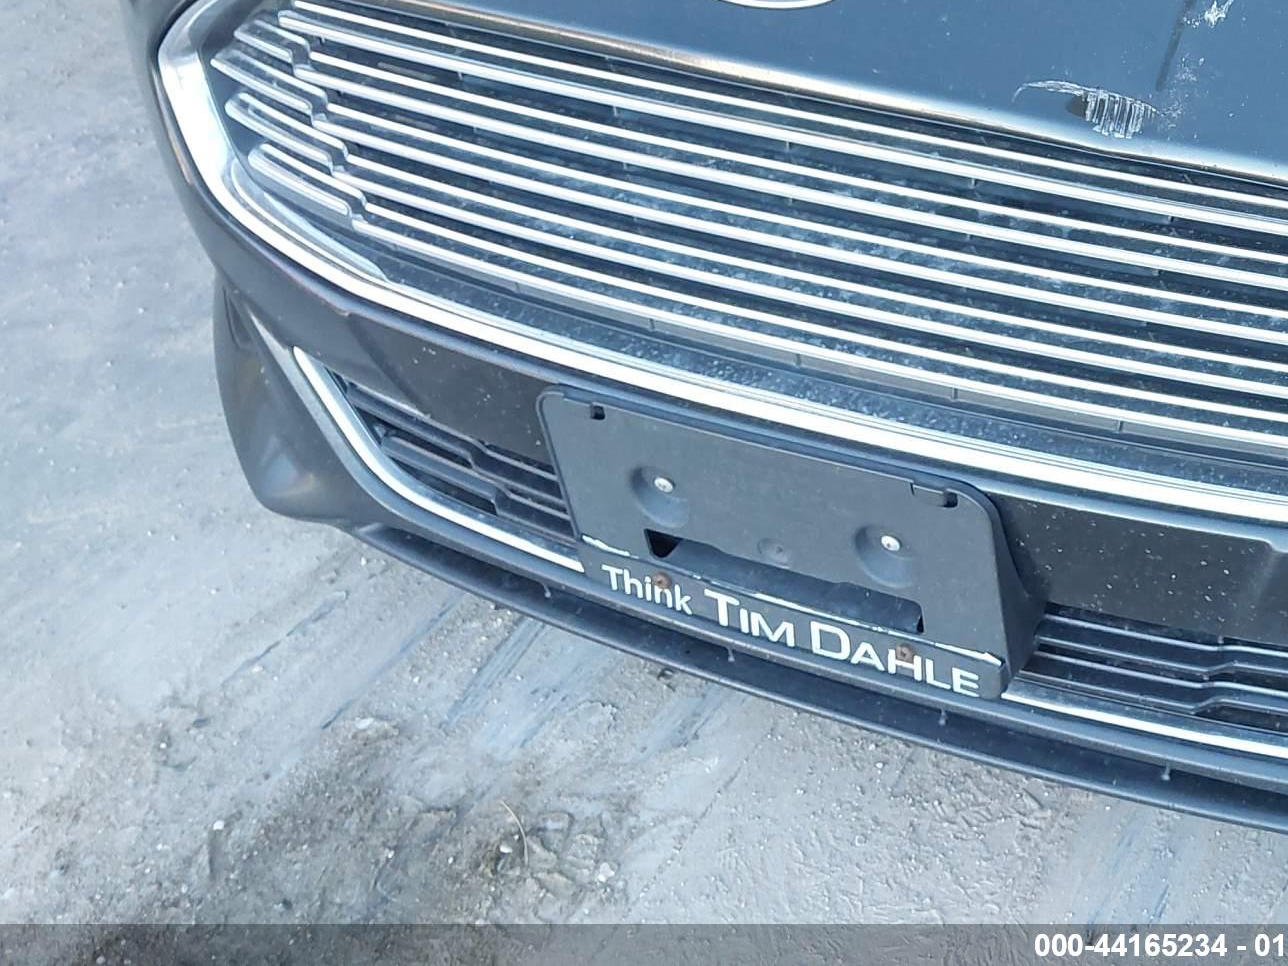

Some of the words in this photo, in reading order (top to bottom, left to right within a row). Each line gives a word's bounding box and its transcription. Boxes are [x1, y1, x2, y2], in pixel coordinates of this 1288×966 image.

[601, 564, 693, 616] Think
[703, 588, 796, 648] TIM
[810, 621, 980, 698] DAHLE
